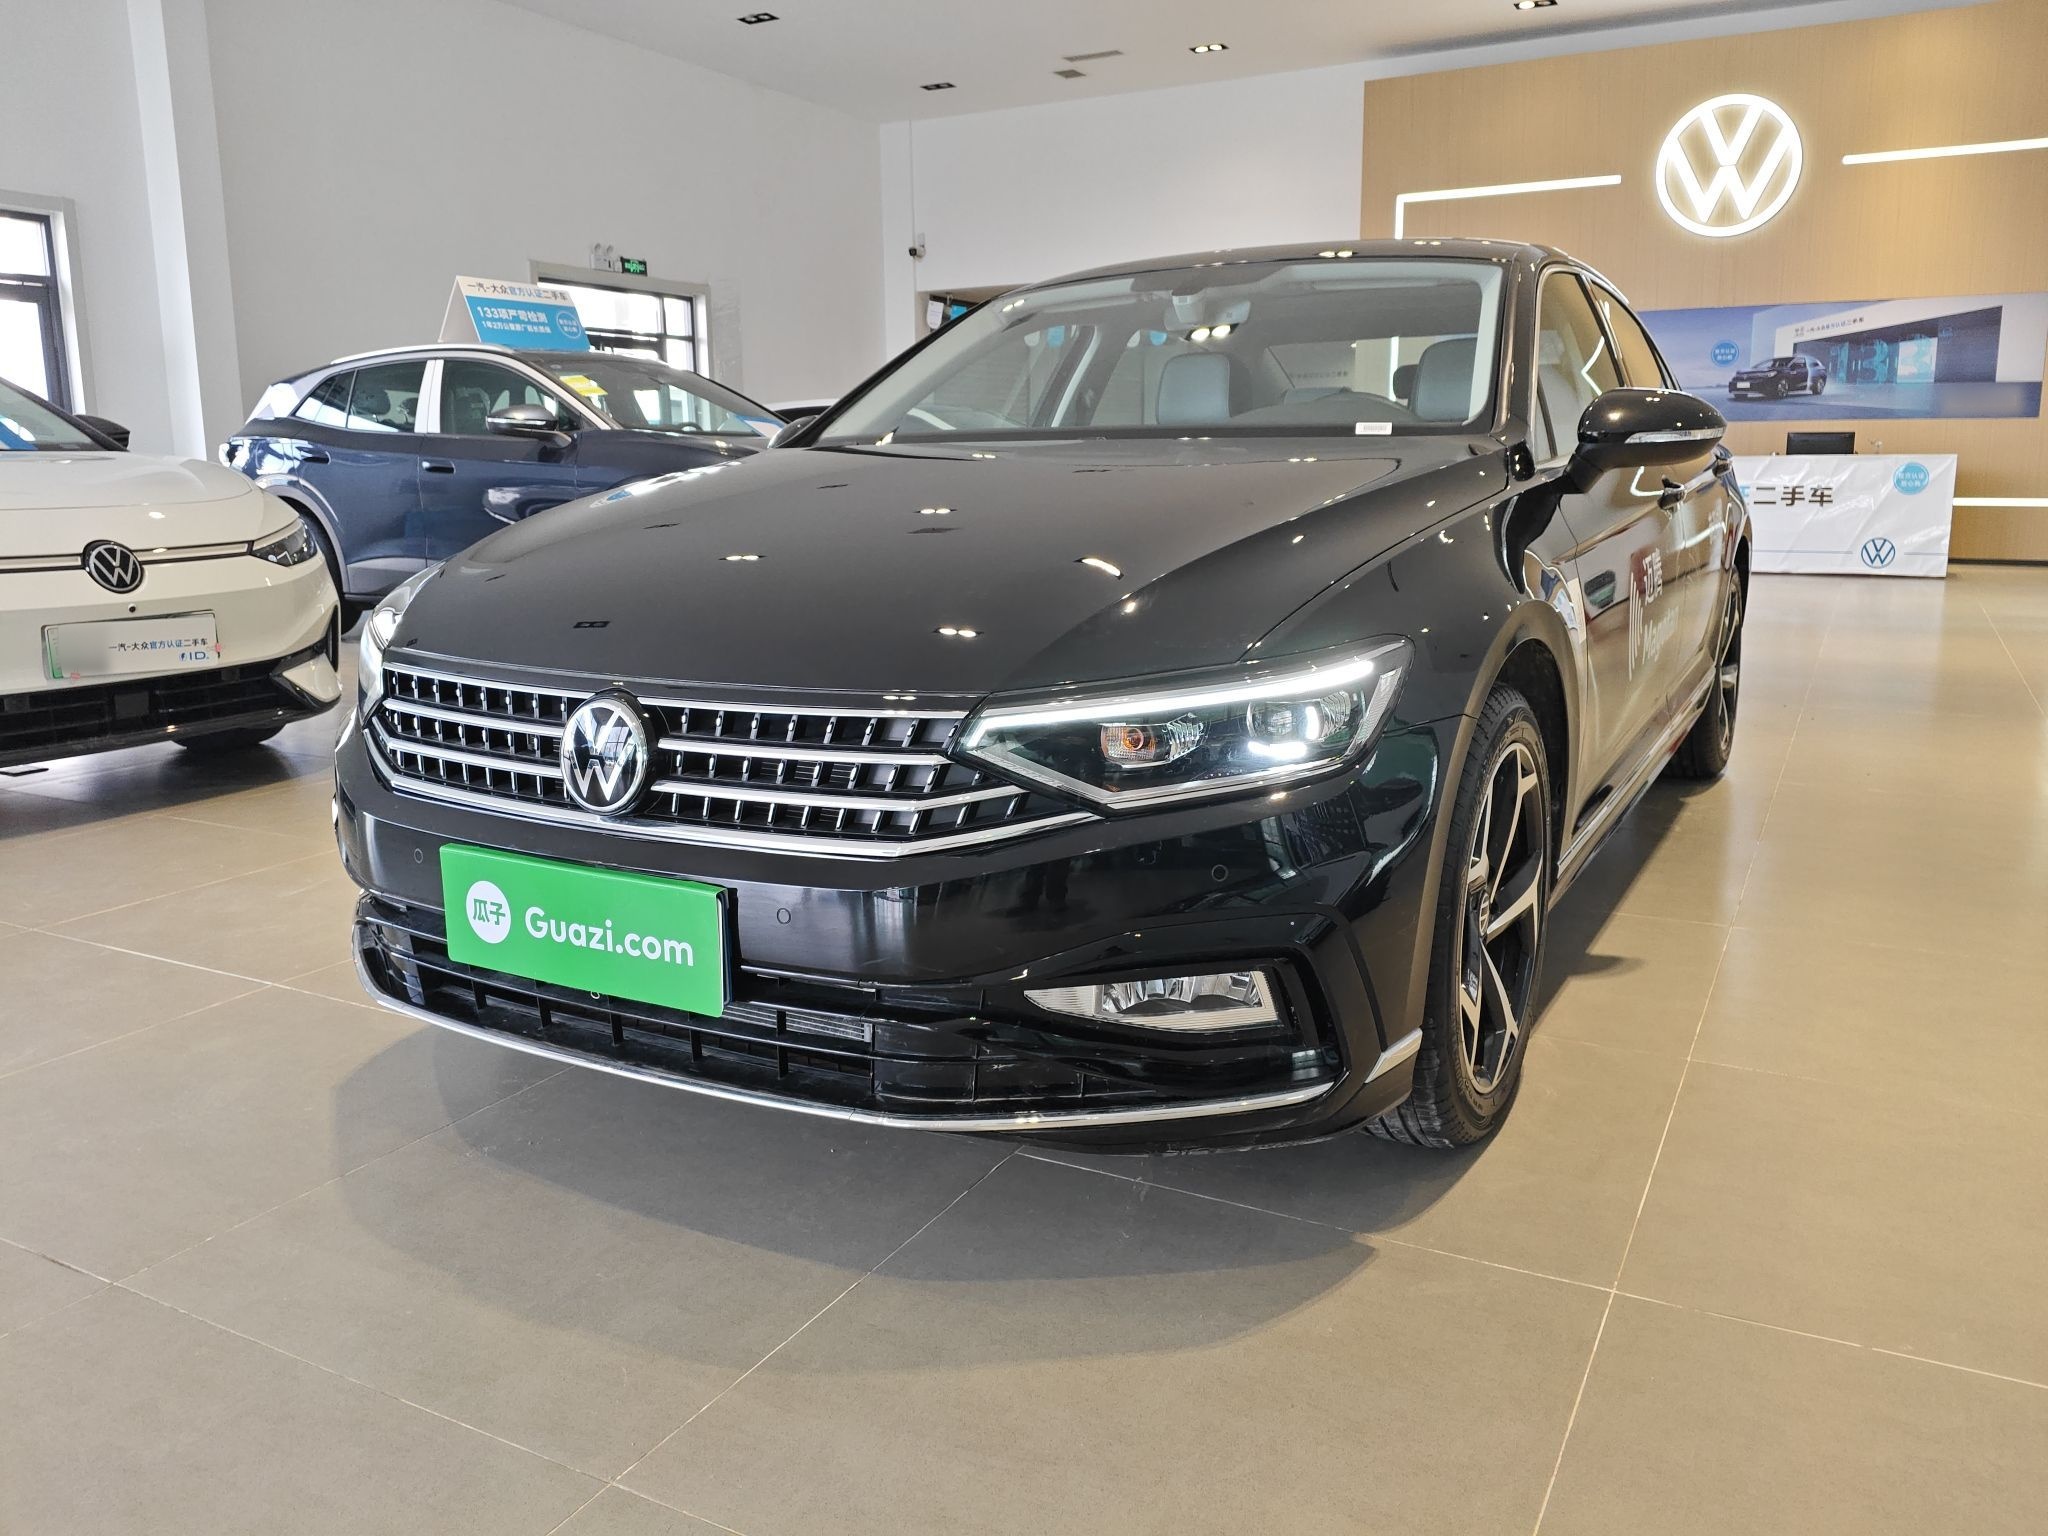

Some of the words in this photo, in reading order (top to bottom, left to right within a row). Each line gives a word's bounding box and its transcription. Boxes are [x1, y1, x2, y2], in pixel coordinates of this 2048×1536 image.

[108, 638, 209, 652] 一汽-大众官方认证二手车
[472, 898, 506, 926] 瓜子
[525, 906, 694, 967] Guazi.com
